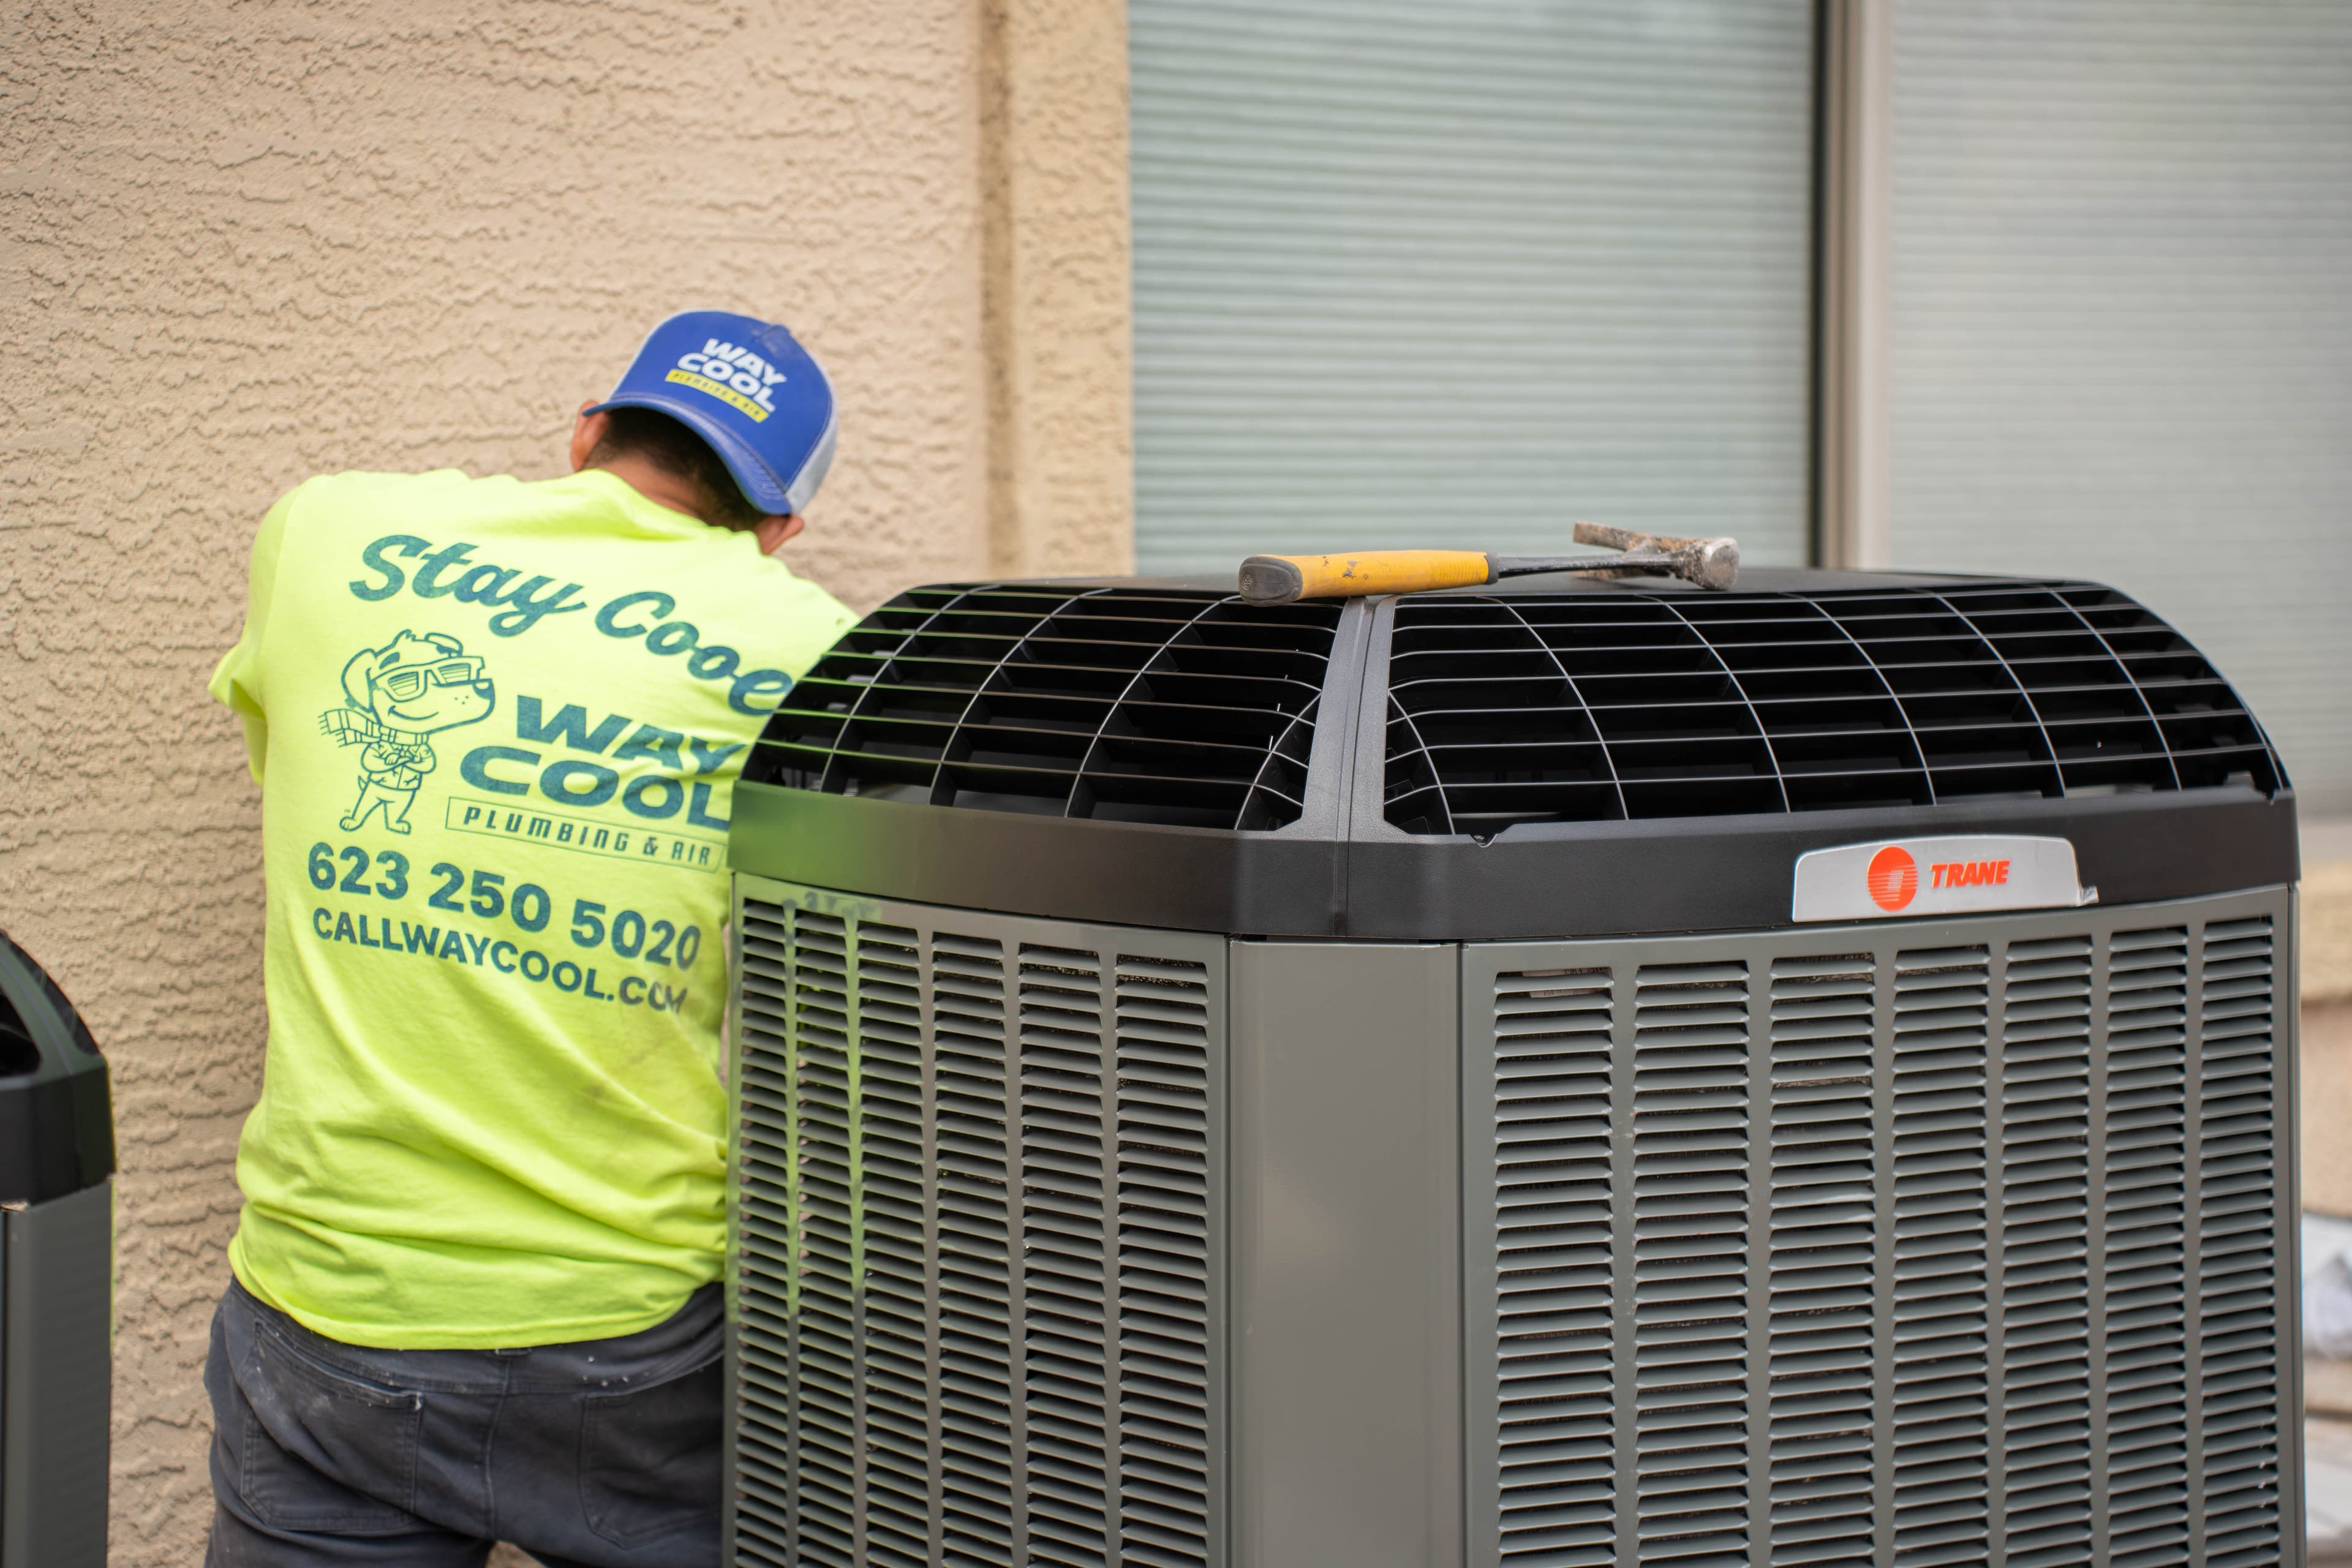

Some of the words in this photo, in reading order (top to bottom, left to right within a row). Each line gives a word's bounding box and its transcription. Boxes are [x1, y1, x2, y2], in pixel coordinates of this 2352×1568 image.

[677, 352, 776, 413] COOL
[701, 338, 787, 386] WAY
[349, 534, 587, 637] Stay
[516, 695, 748, 775] WAY
[459, 745, 731, 833] COOL
[463, 806, 630, 851] PLUMBING
[643, 837, 658, 856] &
[672, 841, 710, 865] AIR
[308, 842, 410, 900] 623
[429, 862, 551, 933] 250
[570, 899, 701, 971] 5020
[1931, 860, 2010, 888] TRANE
